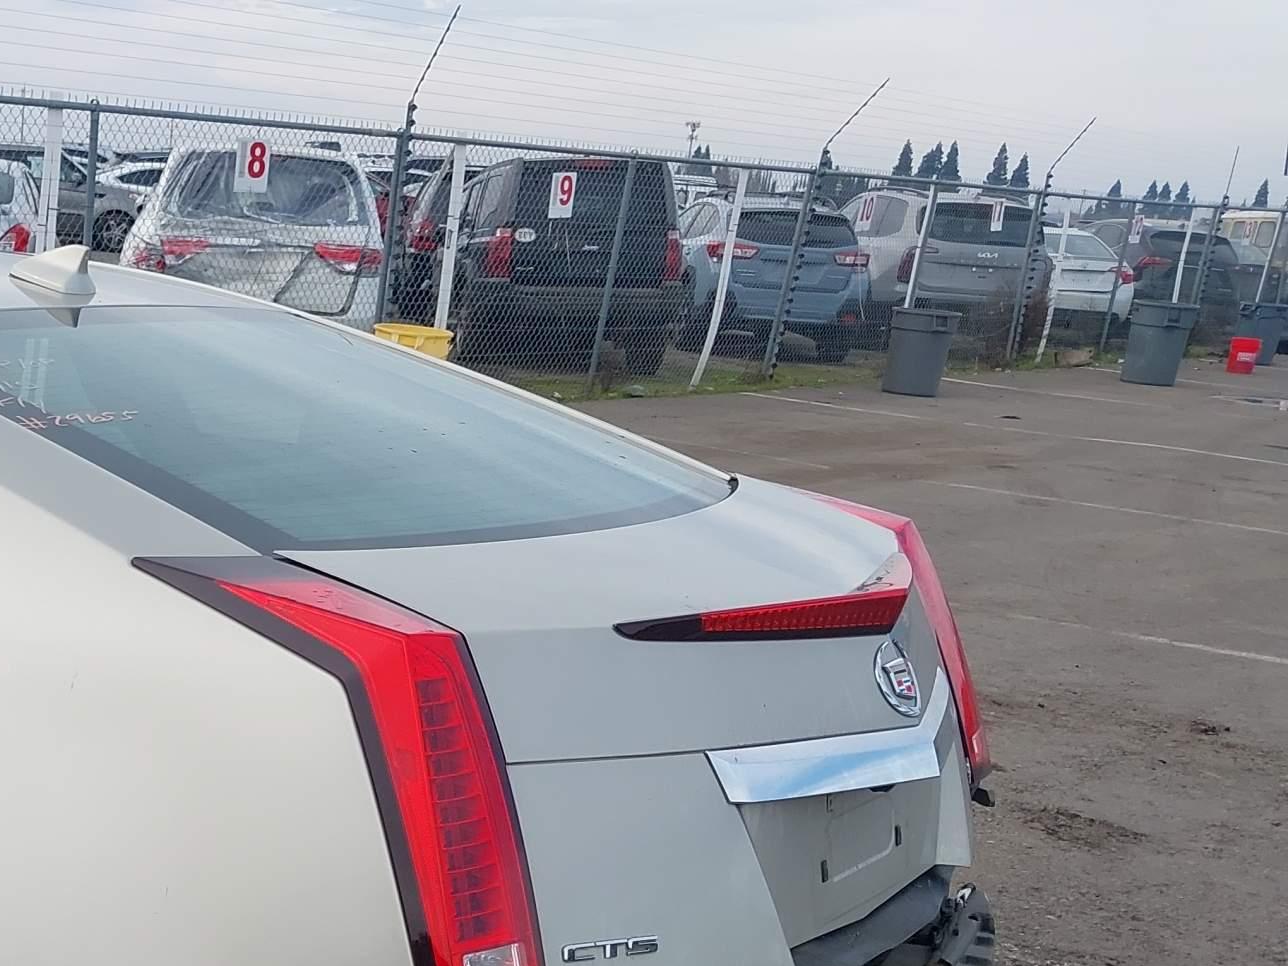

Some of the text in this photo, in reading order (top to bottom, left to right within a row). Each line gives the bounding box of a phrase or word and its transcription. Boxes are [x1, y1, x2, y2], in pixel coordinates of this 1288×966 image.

[248, 142, 266, 179] 8
[559, 175, 573, 206] 9
[860, 196, 874, 221] 10
[562, 935, 658, 962] CTS
